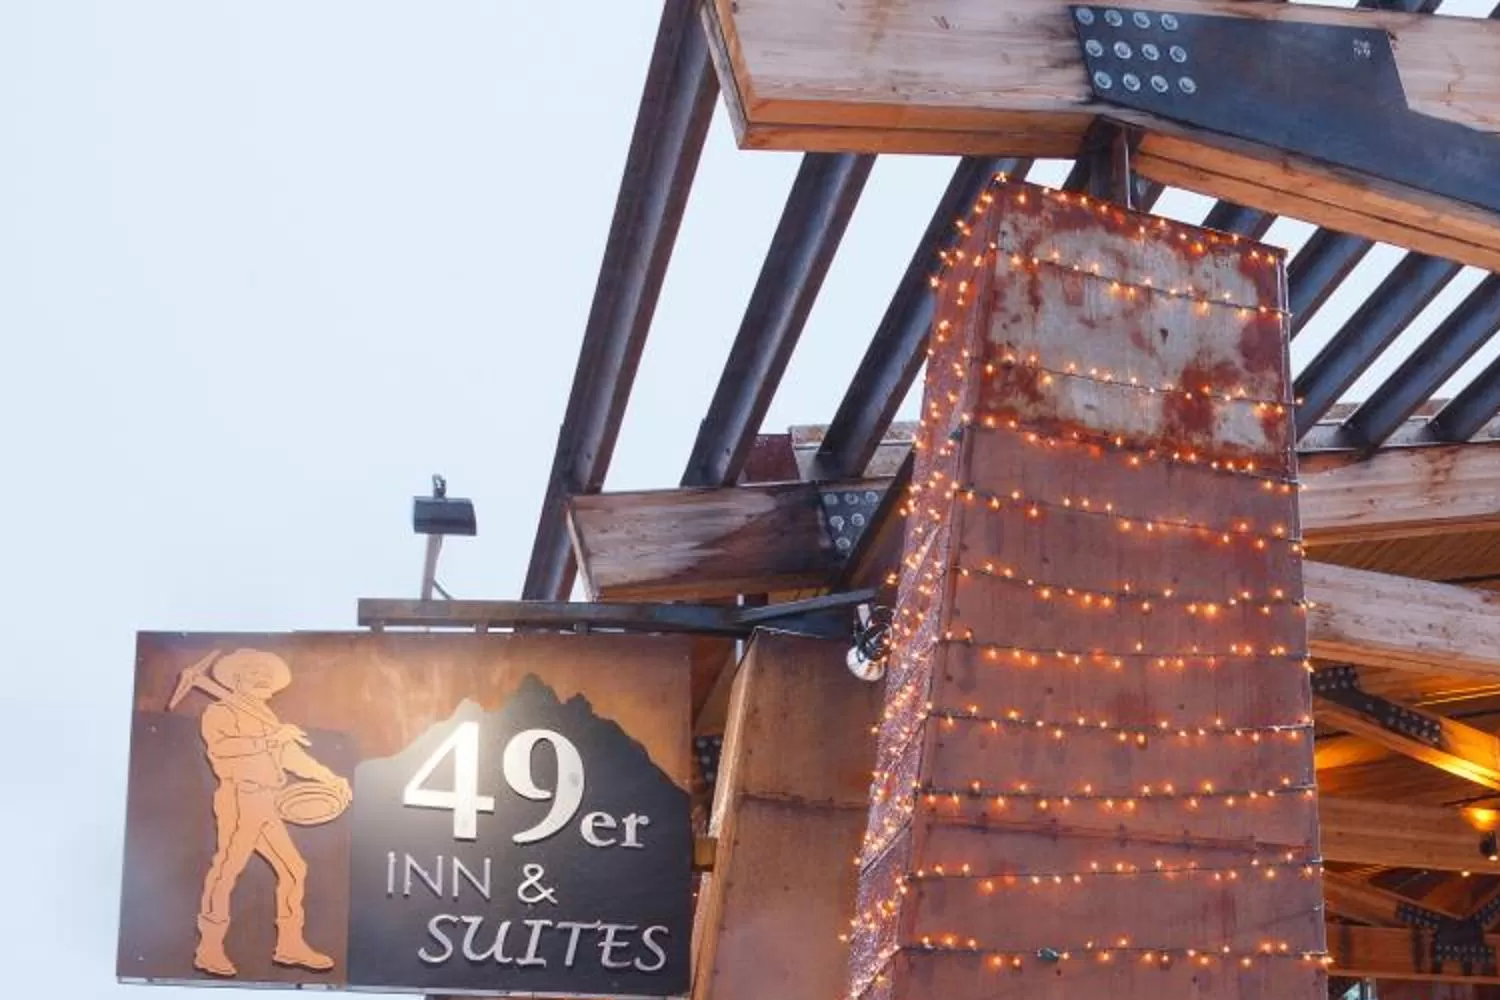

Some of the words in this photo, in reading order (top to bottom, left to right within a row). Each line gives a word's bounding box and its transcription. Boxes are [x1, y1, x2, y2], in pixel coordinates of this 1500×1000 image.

[402, 721, 650, 848] 49er
[386, 851, 492, 899] INN
[516, 863, 558, 904] &
[417, 913, 669, 971] SUITES
